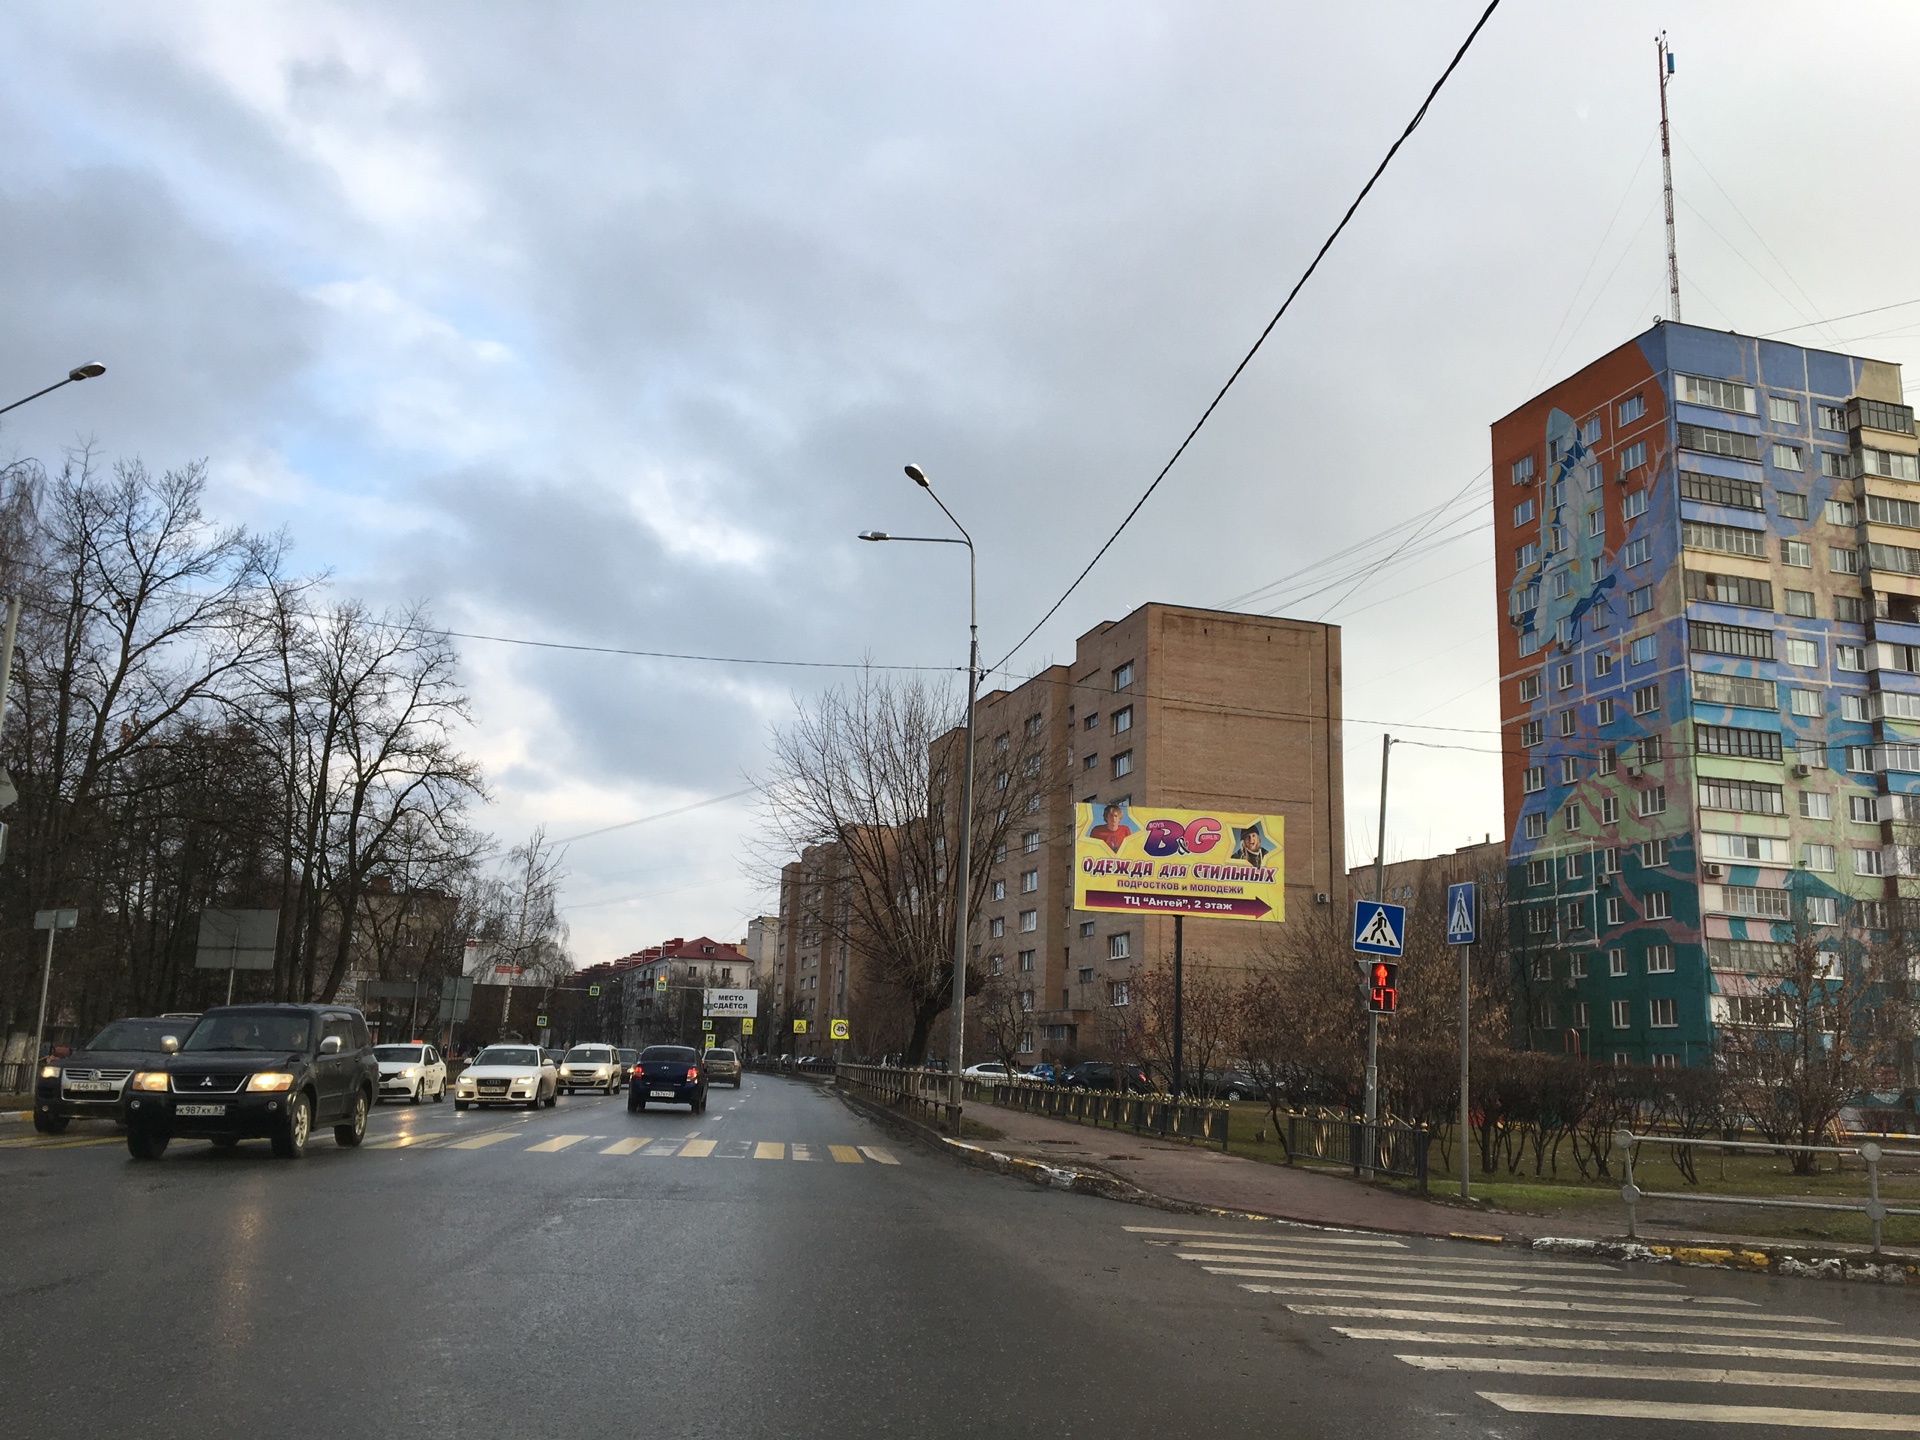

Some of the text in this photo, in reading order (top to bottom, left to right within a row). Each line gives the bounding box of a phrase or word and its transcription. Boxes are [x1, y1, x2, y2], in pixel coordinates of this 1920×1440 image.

[1148, 821, 1165, 829] BOYS
[1083, 858, 1153, 877] ОДЕЖДА
[1193, 862, 1275, 882] СТИЛЬНЫХ
[1117, 880, 1179, 891] ПОДРОСТКОВ
[1190, 884, 1243, 894] МОЛОДЕЖИ
[1124, 896, 1140, 906] ТЦ
[1194, 900, 1201, 908] 2
[1204, 901, 1232, 910] этаж
[1372, 988, 1396, 1010] 47
